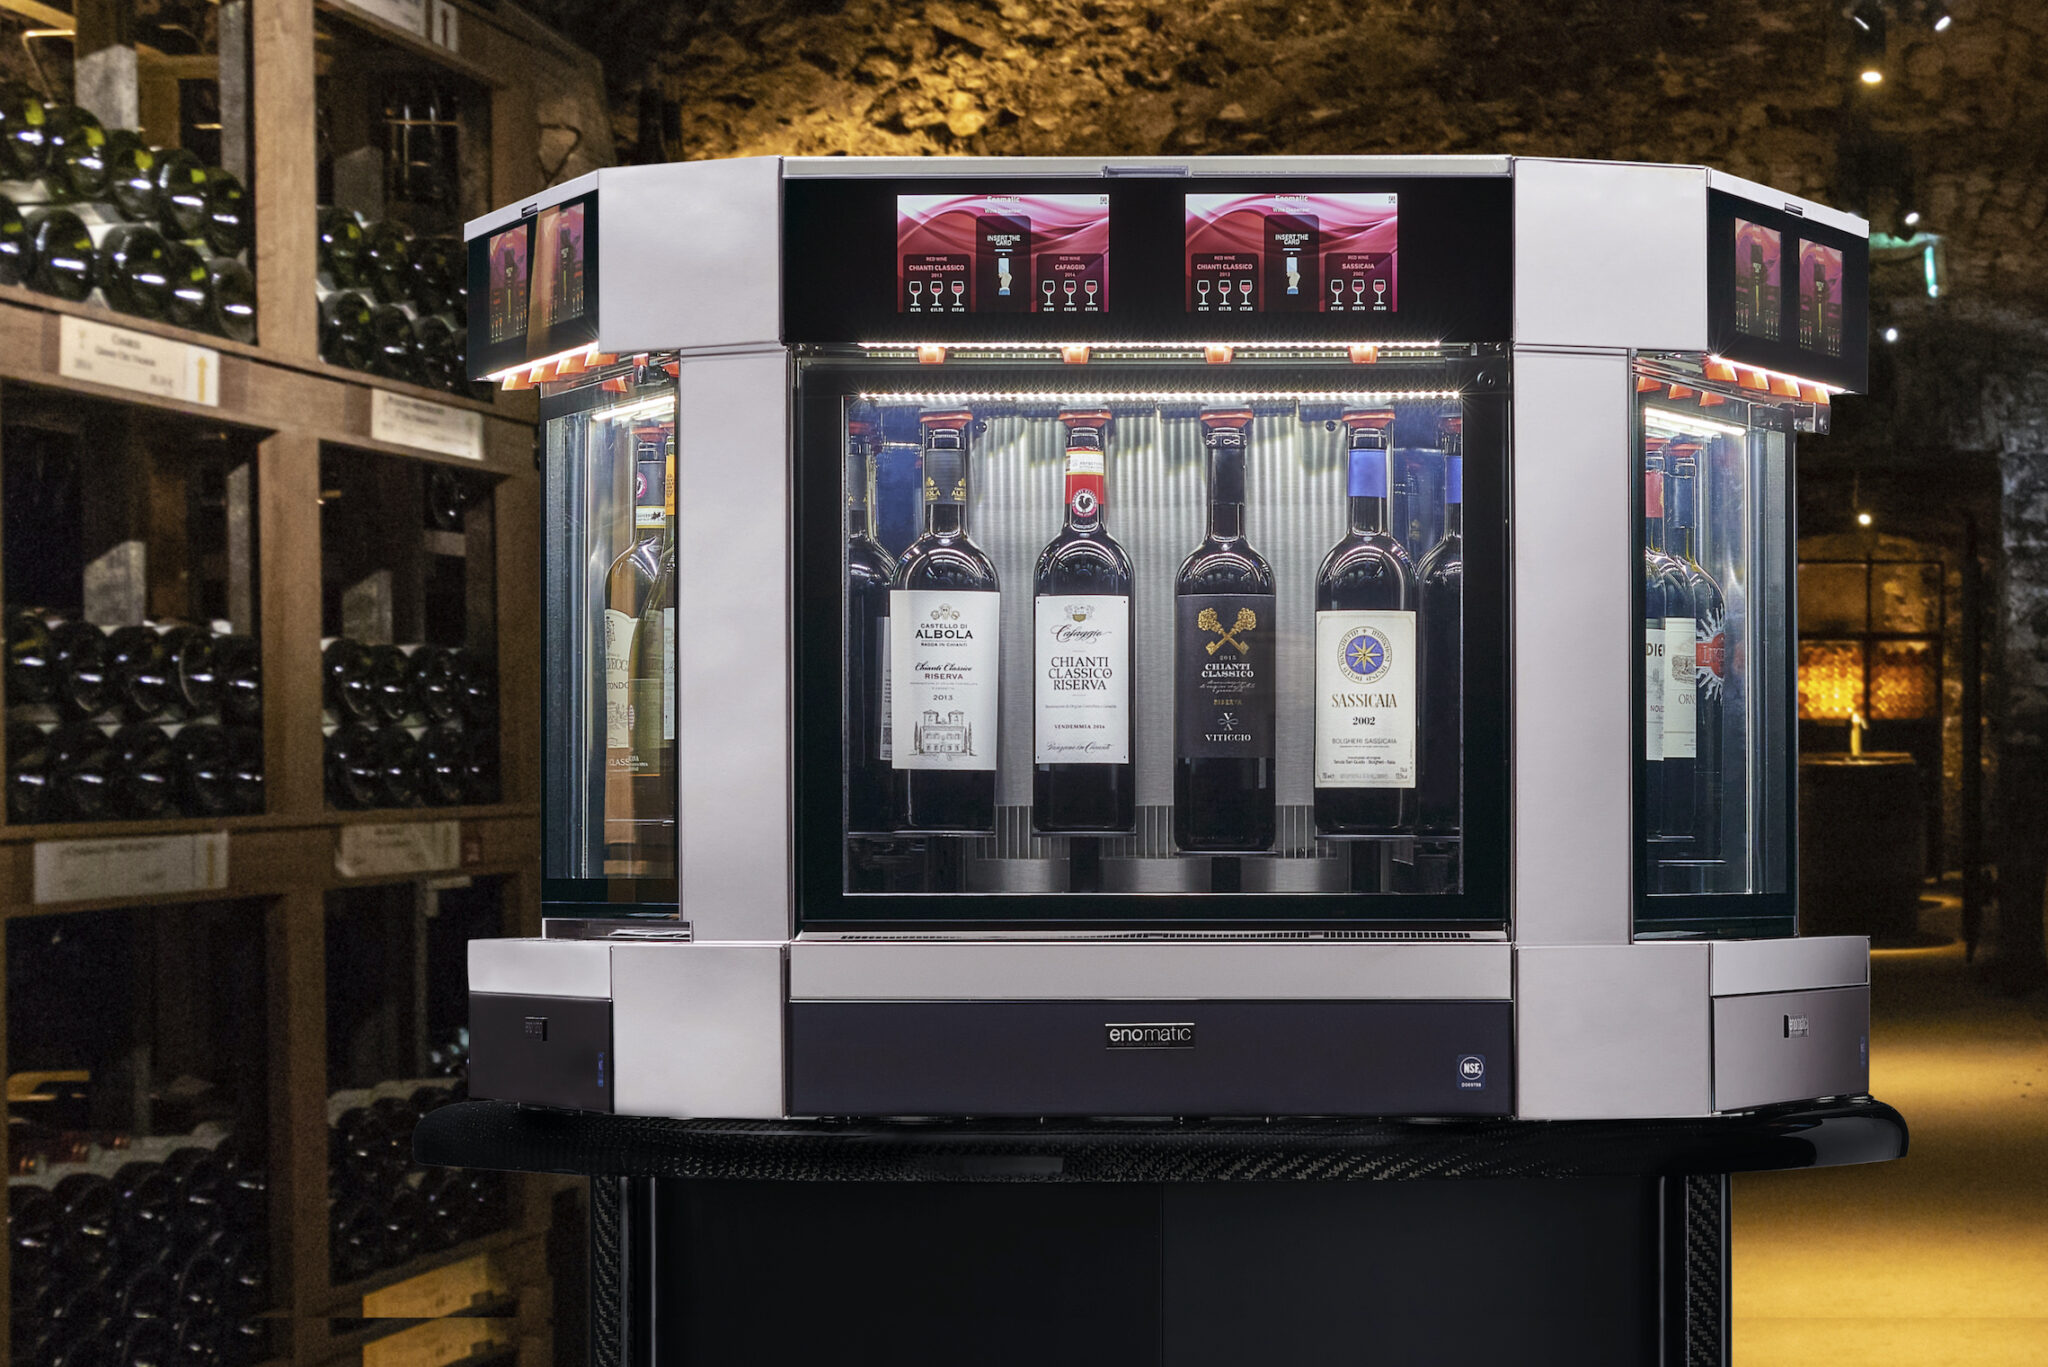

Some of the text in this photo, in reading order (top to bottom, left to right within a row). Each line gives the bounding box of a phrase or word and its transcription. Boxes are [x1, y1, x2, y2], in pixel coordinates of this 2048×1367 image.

[987, 234, 1021, 242] INSERT THE
[1275, 233, 1309, 241] INSERT THE
[915, 629, 974, 639] ALBOLA
[1050, 624, 1112, 644] Cafaggio
[914, 661, 973, 672] Chianti Classico
[1051, 656, 1109, 667] CHIANTI
[1205, 663, 1251, 671] CHIANTI
[1048, 667, 1113, 679] CLASSICO
[1201, 670, 1254, 678] CLASSICO
[1053, 679, 1107, 690] RISERVA
[1331, 693, 1398, 708] SASSICAIA
[1352, 716, 1376, 726] 2002
[1204, 733, 1252, 742] VITICCIO
[1109, 1026, 1191, 1042] enomatic
[1463, 1062, 1480, 1074] NSF
